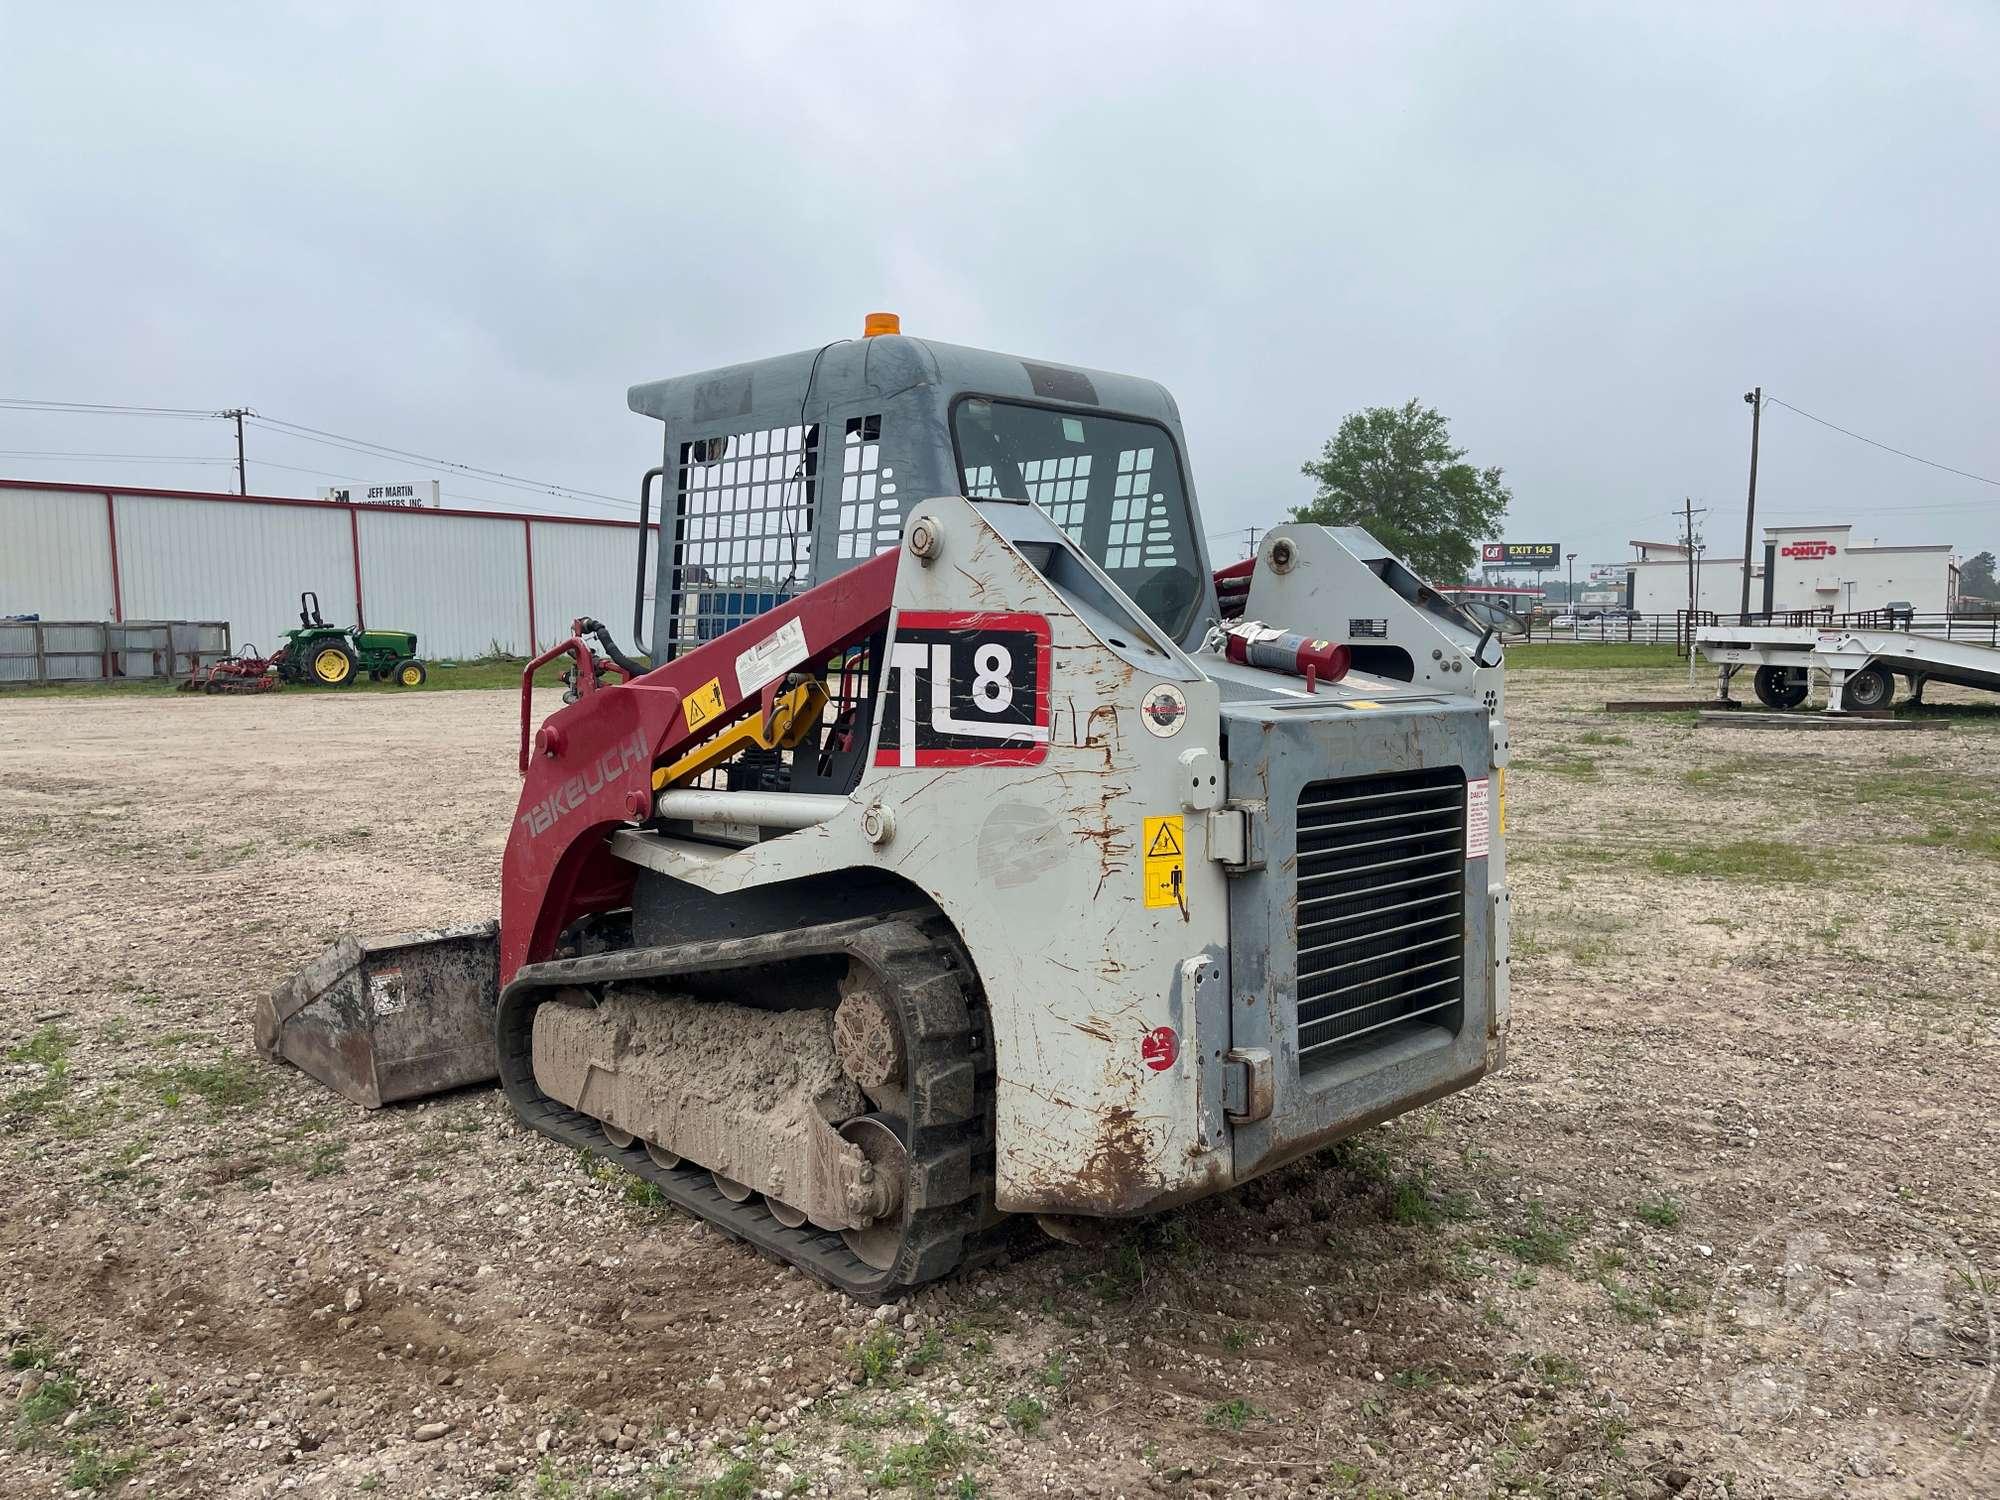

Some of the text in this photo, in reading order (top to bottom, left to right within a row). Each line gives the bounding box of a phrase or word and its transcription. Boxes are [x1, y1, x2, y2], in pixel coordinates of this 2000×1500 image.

[367, 485, 413, 498] JEFF MARTIN
[1485, 545, 1553, 558] QT EXIT 143
[1782, 546, 1836, 556] DONUTS
[890, 642, 1049, 767] TL8
[520, 727, 649, 839] TAKEUCHI
